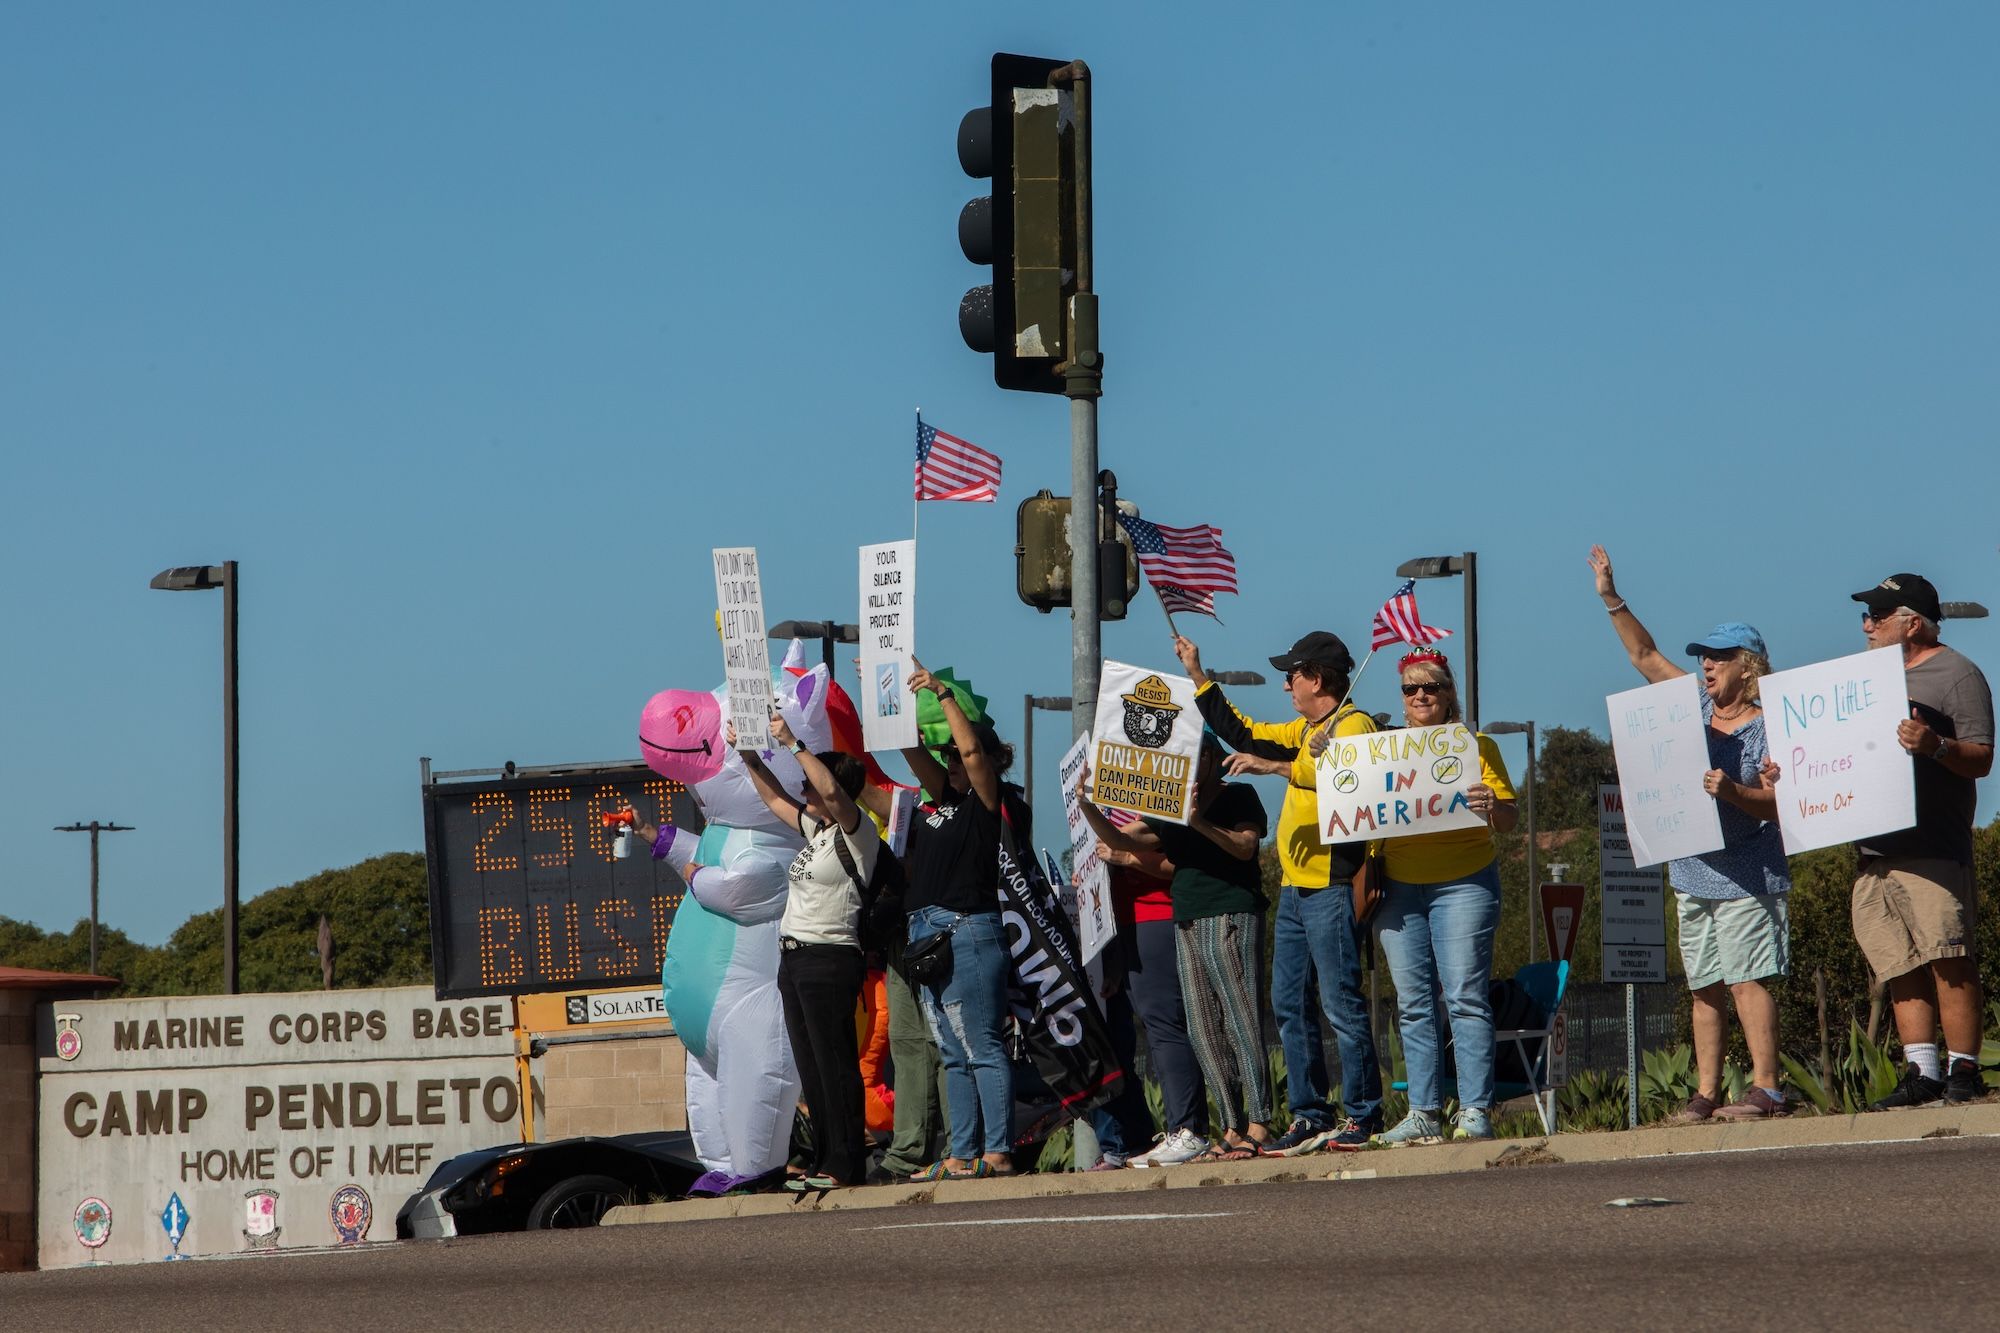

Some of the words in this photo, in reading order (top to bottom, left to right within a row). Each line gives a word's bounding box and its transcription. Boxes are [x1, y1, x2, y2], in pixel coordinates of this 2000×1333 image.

[715, 553, 728, 586] YOU
[728, 552, 742, 577] DON'T
[742, 552, 757, 577] HAVE
[876, 550, 896, 566] YOUR
[724, 582, 731, 604] TO
[731, 581, 740, 605] BE
[740, 581, 748, 603] ON
[747, 580, 758, 604] THE
[873, 571, 901, 587] SILENCE
[868, 594, 885, 608] WILL
[887, 592, 902, 607] NOT
[723, 610, 740, 640] LEFT
[742, 609, 750, 633] TO
[751, 610, 760, 634] DO
[869, 613, 900, 629] PROTECT
[726, 644, 745, 669] WHAT'S
[878, 634, 894, 649] YOU
[739, 678, 748, 694] ONLY
[1137, 687, 1168, 702] RESIST
[744, 697, 752, 713] NOT
[758, 698, 766, 715] LET
[1626, 706, 1658, 739] HATE
[1667, 703, 1691, 723] WILL
[1783, 693, 1825, 738] NO
[1101, 744, 1147, 772] ONLY
[1151, 753, 1185, 780] YOU
[1317, 743, 1357, 771] NO
[1368, 726, 1469, 765] KINGS
[1650, 738, 1675, 774] NOT
[1061, 744, 1087, 785] Democracy
[1792, 746, 1853, 785] Princes
[1099, 768, 1124, 786] CAN
[1127, 773, 1183, 797] PREVENT
[1385, 768, 1417, 792] IN
[1671, 783, 1685, 799] US
[1097, 784, 1144, 807] FASCIST
[1146, 795, 1180, 814] LIARS
[1327, 791, 1469, 837] AMERICA
[1799, 797, 1828, 819] Vance
[1834, 788, 1854, 811] Out
[1076, 849, 1101, 887] ICTATO
[1611, 970, 1629, 978] MILITARY
[113, 1016, 244, 1051] MARINE
[269, 1009, 387, 1045] CORPS
[413, 1004, 503, 1039] BASE
[63, 1087, 207, 1138] CAMP
[181, 1148, 275, 1181] HOME
[290, 1145, 335, 1178] OF
[349, 1145, 356, 1177] I
[369, 1142, 435, 1175] MEF
